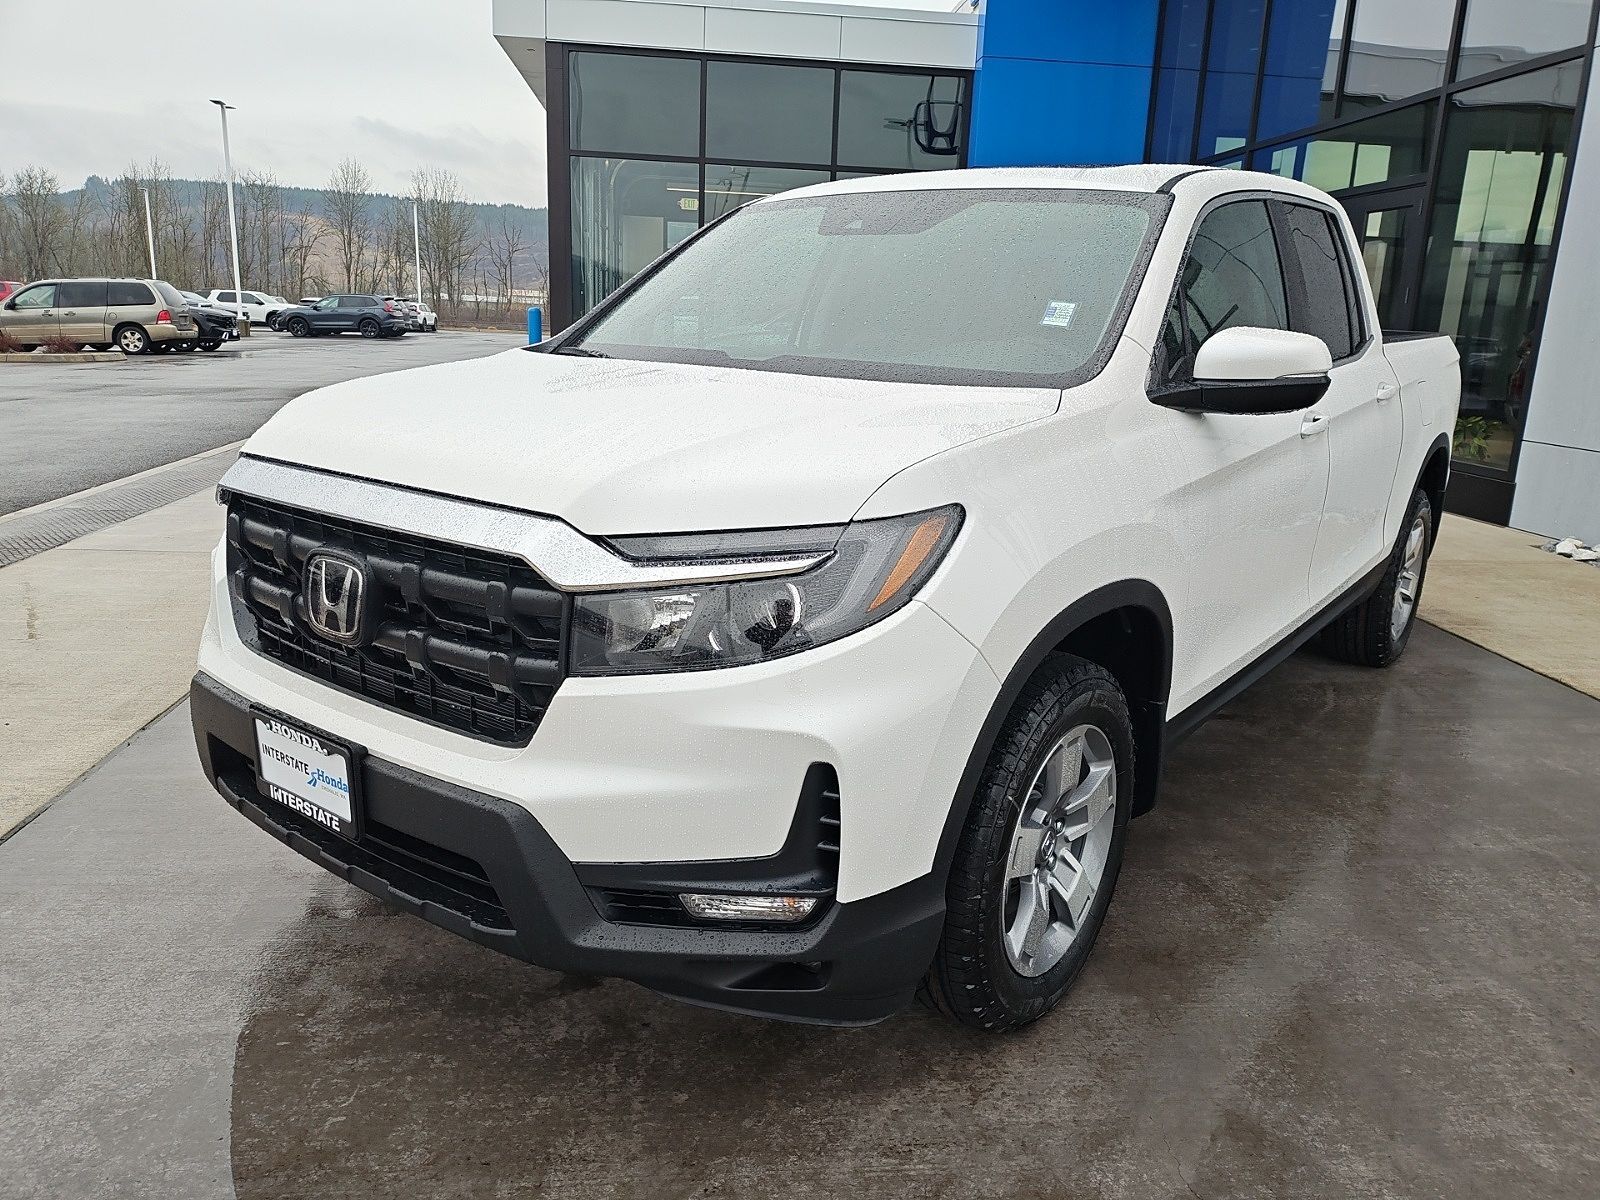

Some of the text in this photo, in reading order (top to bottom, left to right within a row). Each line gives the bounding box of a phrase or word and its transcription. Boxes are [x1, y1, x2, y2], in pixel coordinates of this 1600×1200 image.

[270, 720, 321, 752] HONDA
[261, 743, 310, 776] INTERSTATE
[316, 768, 350, 793] Honda
[269, 784, 341, 831] INTERSTATE
